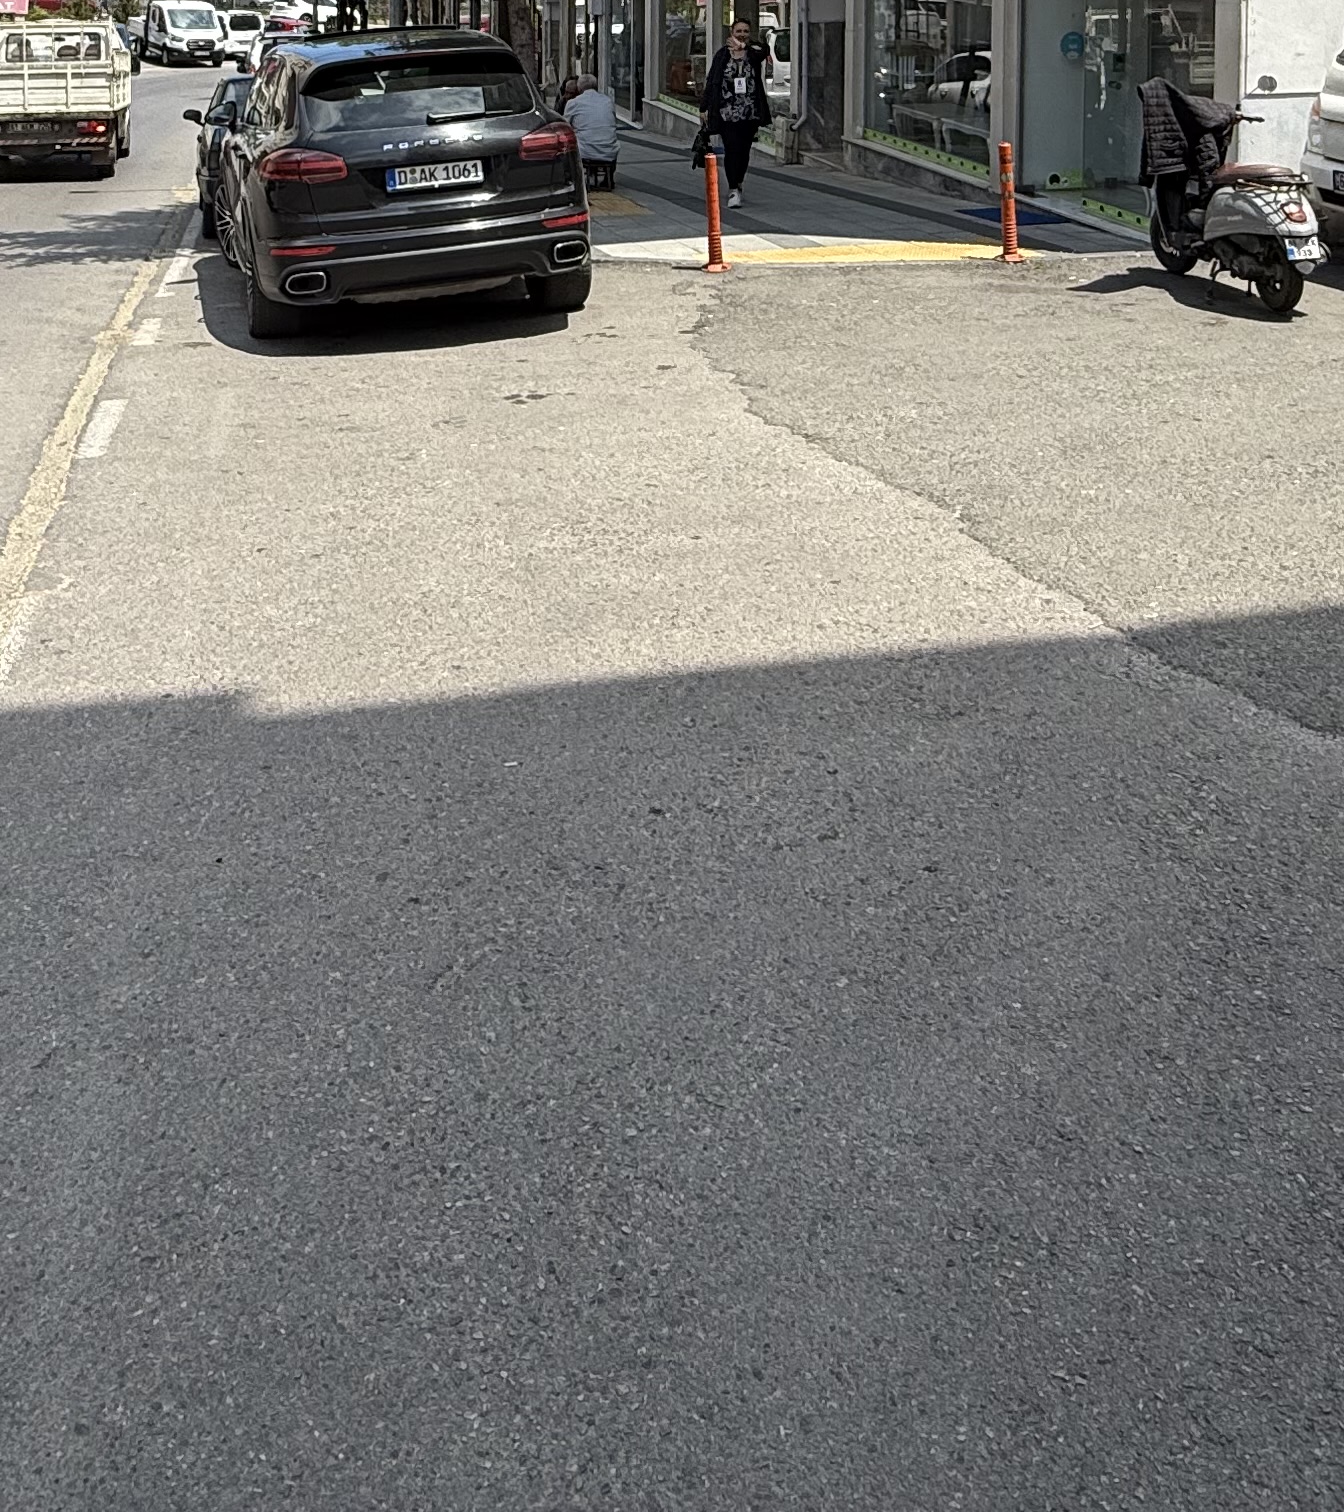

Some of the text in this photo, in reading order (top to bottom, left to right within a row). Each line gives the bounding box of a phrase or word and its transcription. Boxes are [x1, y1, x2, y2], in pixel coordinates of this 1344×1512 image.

[397, 162, 481, 186] D AK 1061
